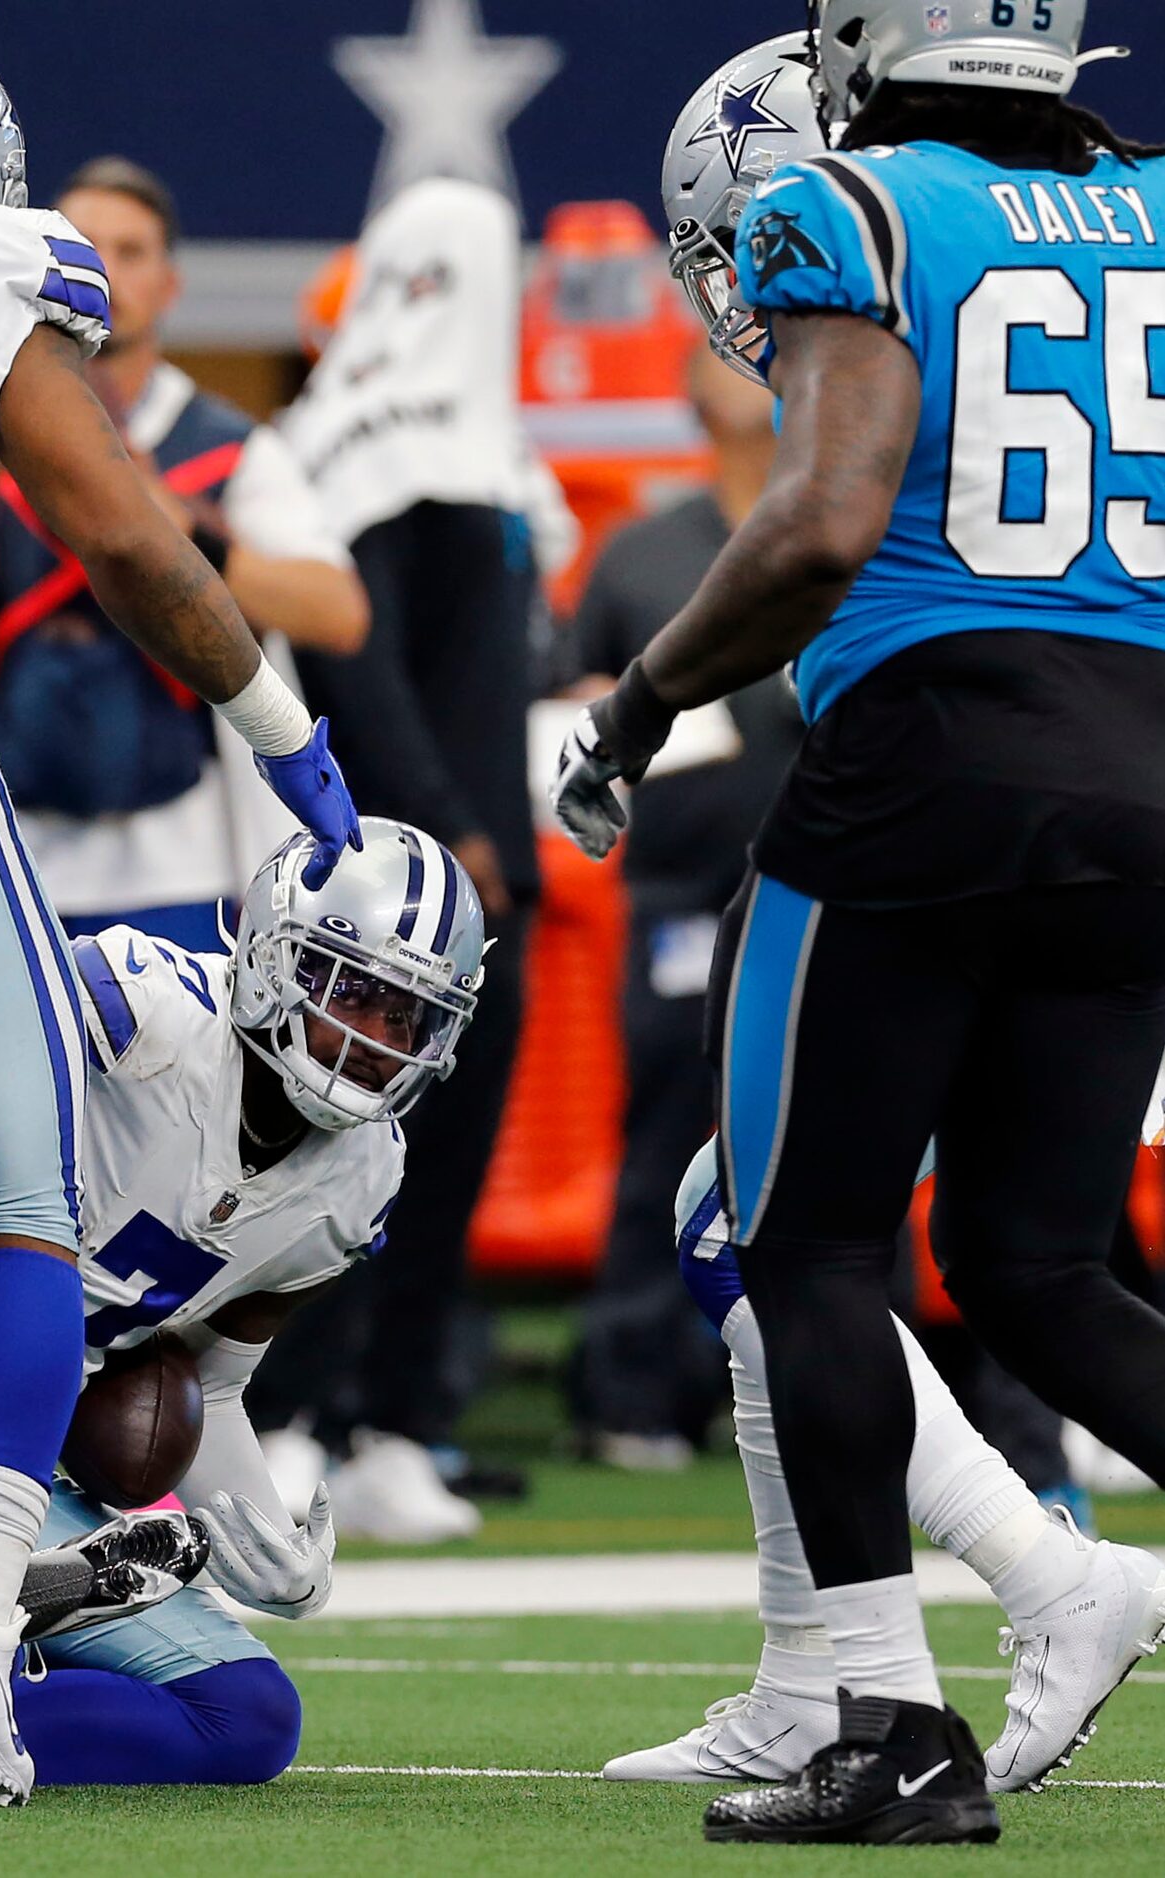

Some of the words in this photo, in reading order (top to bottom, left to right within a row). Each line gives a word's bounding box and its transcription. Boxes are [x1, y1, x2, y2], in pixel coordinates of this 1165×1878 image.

[949, 60, 1013, 76] INSPIRE
[1017, 65, 1064, 84] CHANGE
[988, 181, 1157, 245] DALEY
[84, 1208, 229, 1348] 7
[1066, 1599, 1097, 1617] VAPOR
